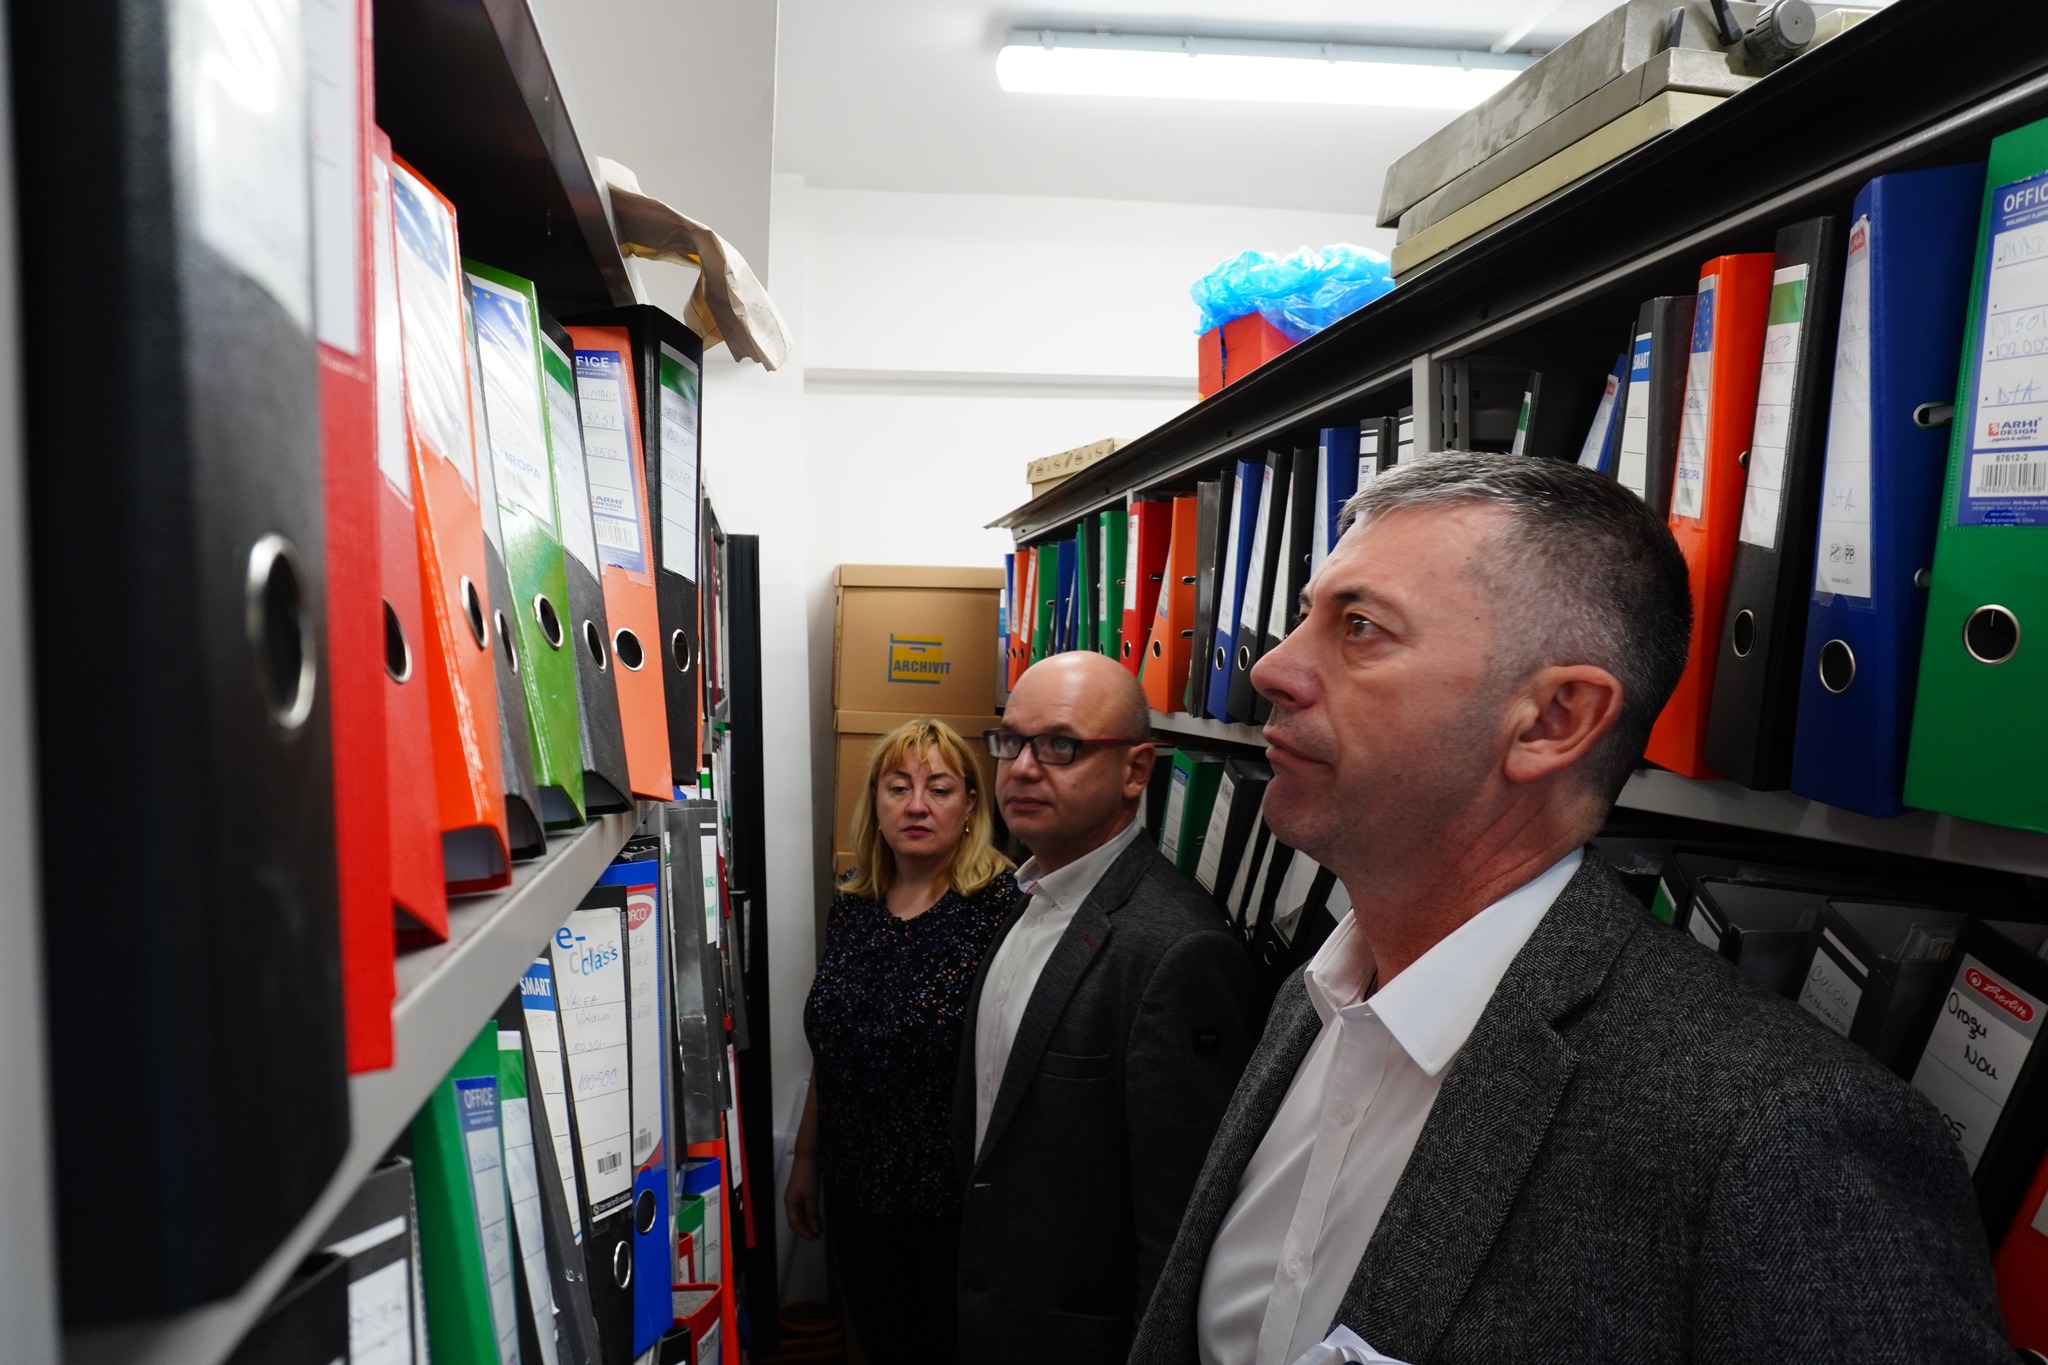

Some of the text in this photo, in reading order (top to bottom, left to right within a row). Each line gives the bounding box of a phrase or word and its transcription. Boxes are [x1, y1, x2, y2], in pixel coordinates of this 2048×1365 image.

[577, 356, 610, 368] FICE
[1632, 351, 1650, 370] SMART
[2002, 419, 2038, 429] ARHI
[1996, 454, 2028, 462] 87612-2
[1679, 467, 1700, 481] EUROPA
[893, 660, 952, 674] ARCHIVIT
[520, 976, 551, 997] SMART
[464, 1087, 494, 1108] OFFICE
